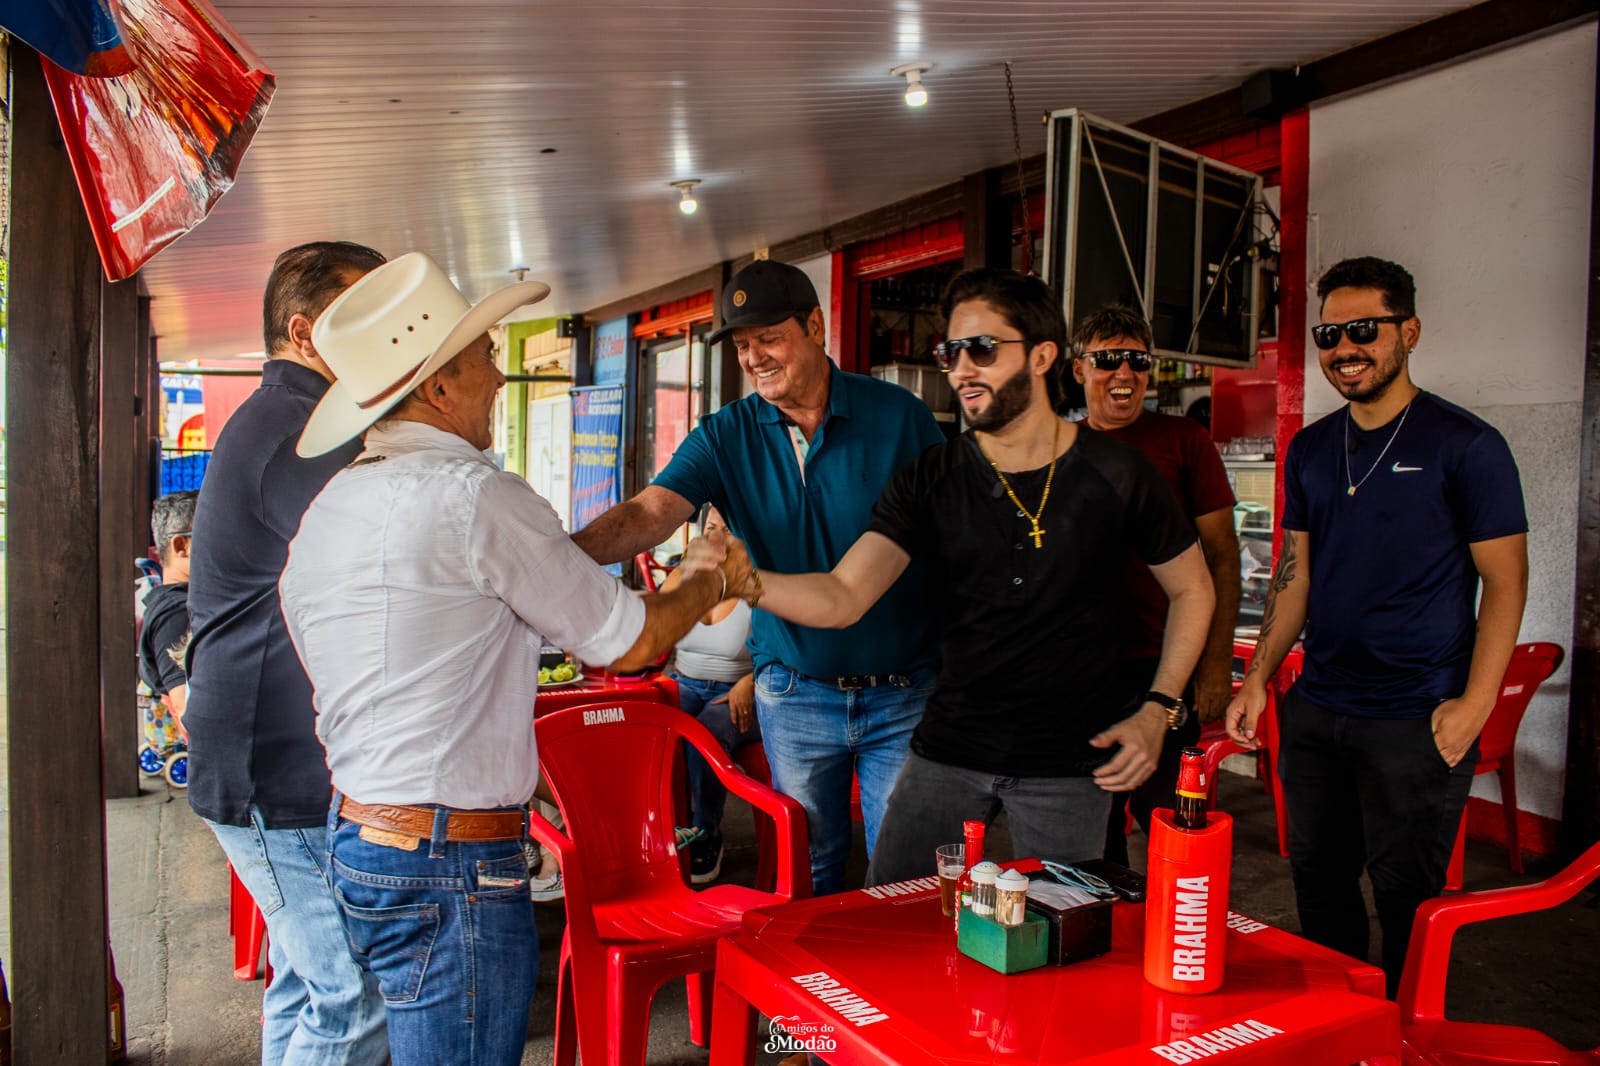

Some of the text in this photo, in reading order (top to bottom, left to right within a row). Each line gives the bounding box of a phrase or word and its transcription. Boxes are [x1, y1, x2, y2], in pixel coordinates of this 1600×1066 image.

[582, 707, 625, 726] BRAHMA
[1172, 875, 1210, 981] BRAHMA
[790, 971, 890, 1027] BRAHMA
[1150, 1019, 1286, 1066] BRAHMA
